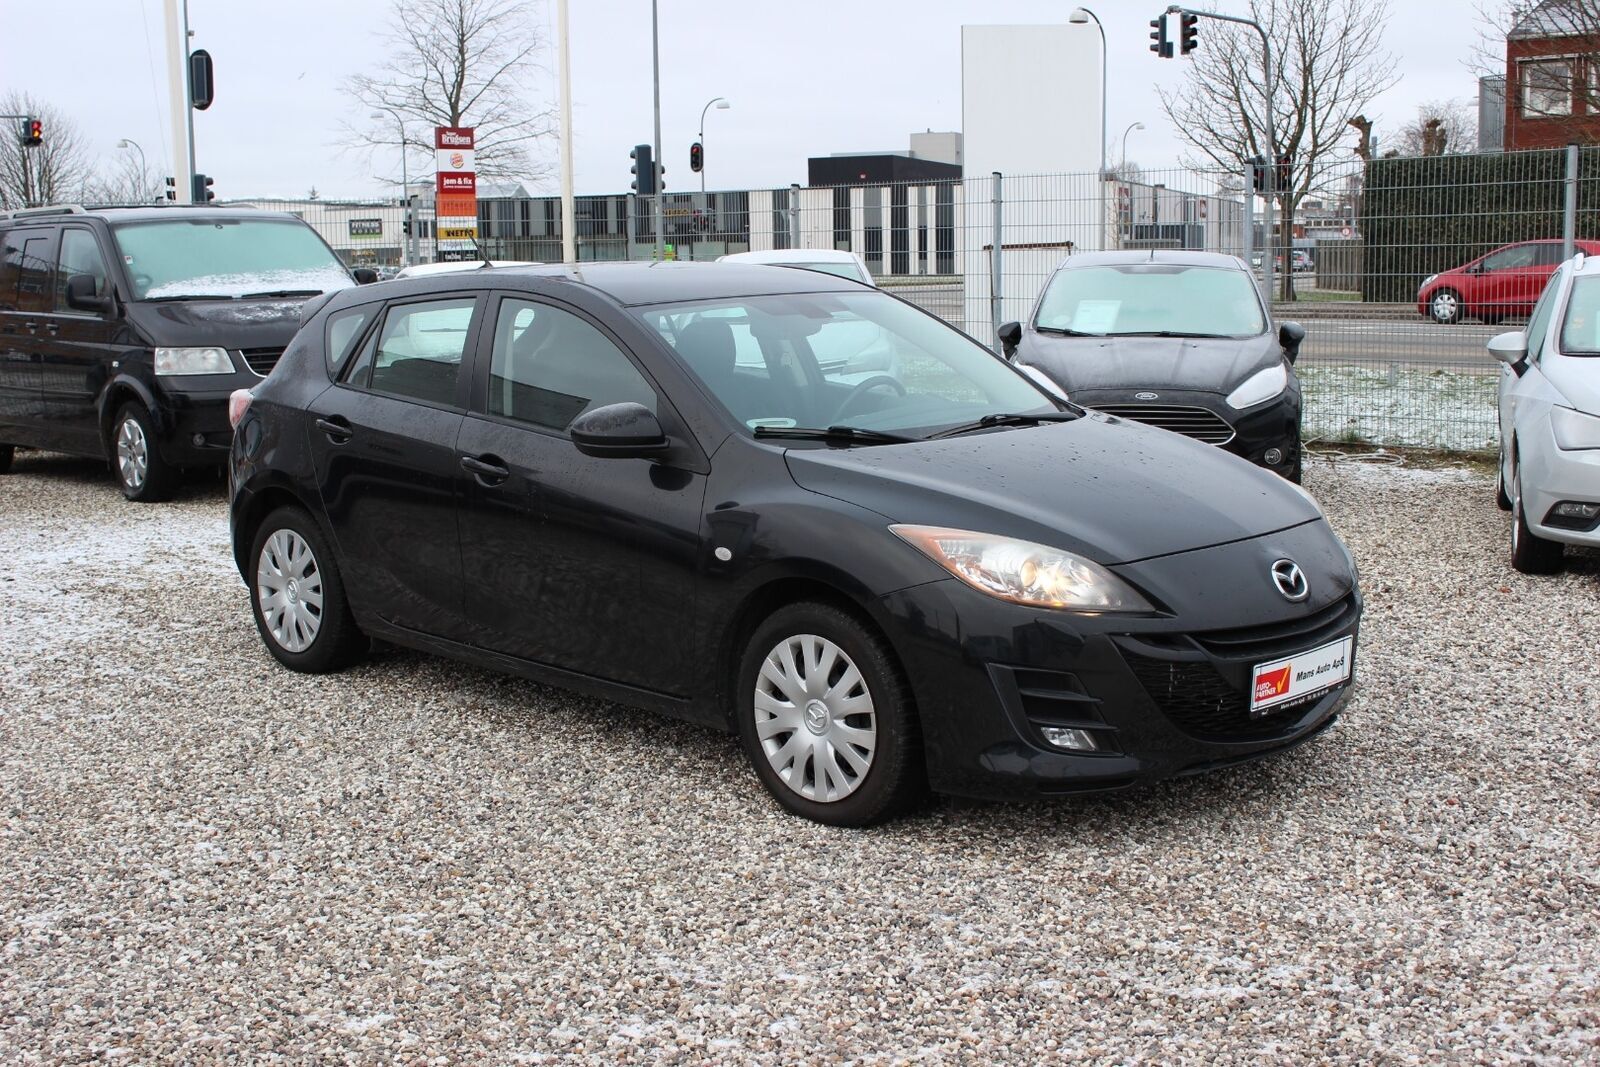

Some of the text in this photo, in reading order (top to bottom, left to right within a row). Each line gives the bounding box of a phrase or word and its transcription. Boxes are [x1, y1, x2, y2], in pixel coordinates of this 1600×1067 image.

[441, 134, 471, 145] Brugsen
[463, 177, 472, 185] fix
[1296, 656, 1344, 682] Mans Auto ApS
[1255, 687, 1277, 698] PARTNER
